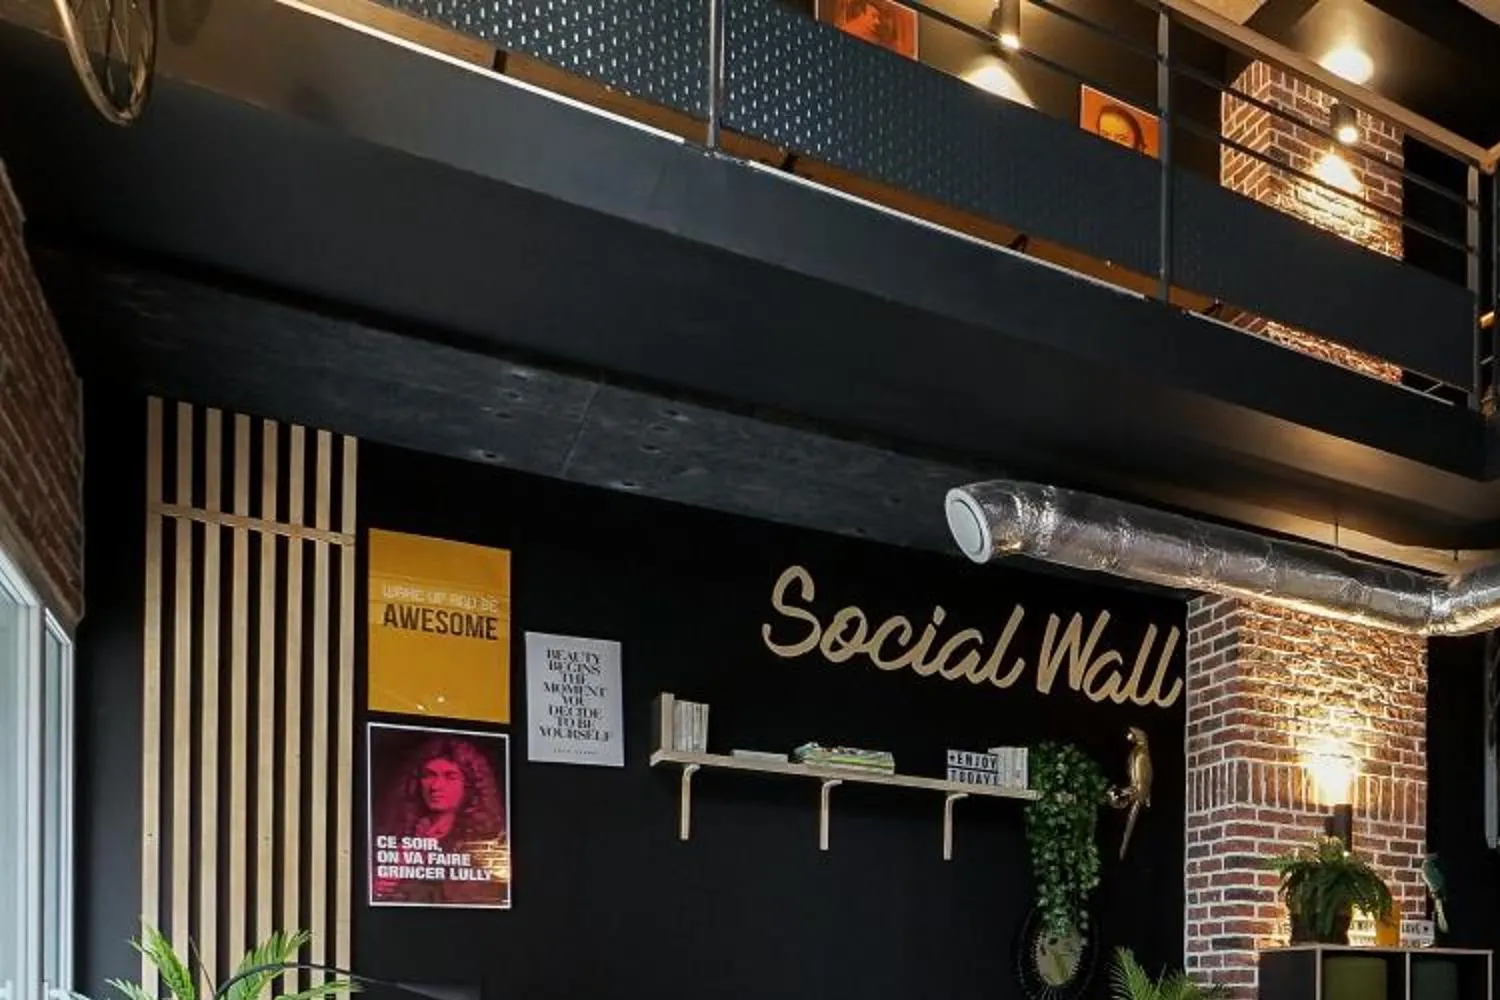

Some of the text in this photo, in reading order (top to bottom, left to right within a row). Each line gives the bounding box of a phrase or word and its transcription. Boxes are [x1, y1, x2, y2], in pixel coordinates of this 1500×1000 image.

[383, 603, 499, 641] AWESOME
[762, 565, 1182, 708] Social Wall
[376, 835, 442, 851] CE SOIR,
[377, 850, 472, 867] ON VA FAIRE
[377, 865, 493, 881] GRINCER LULLY
